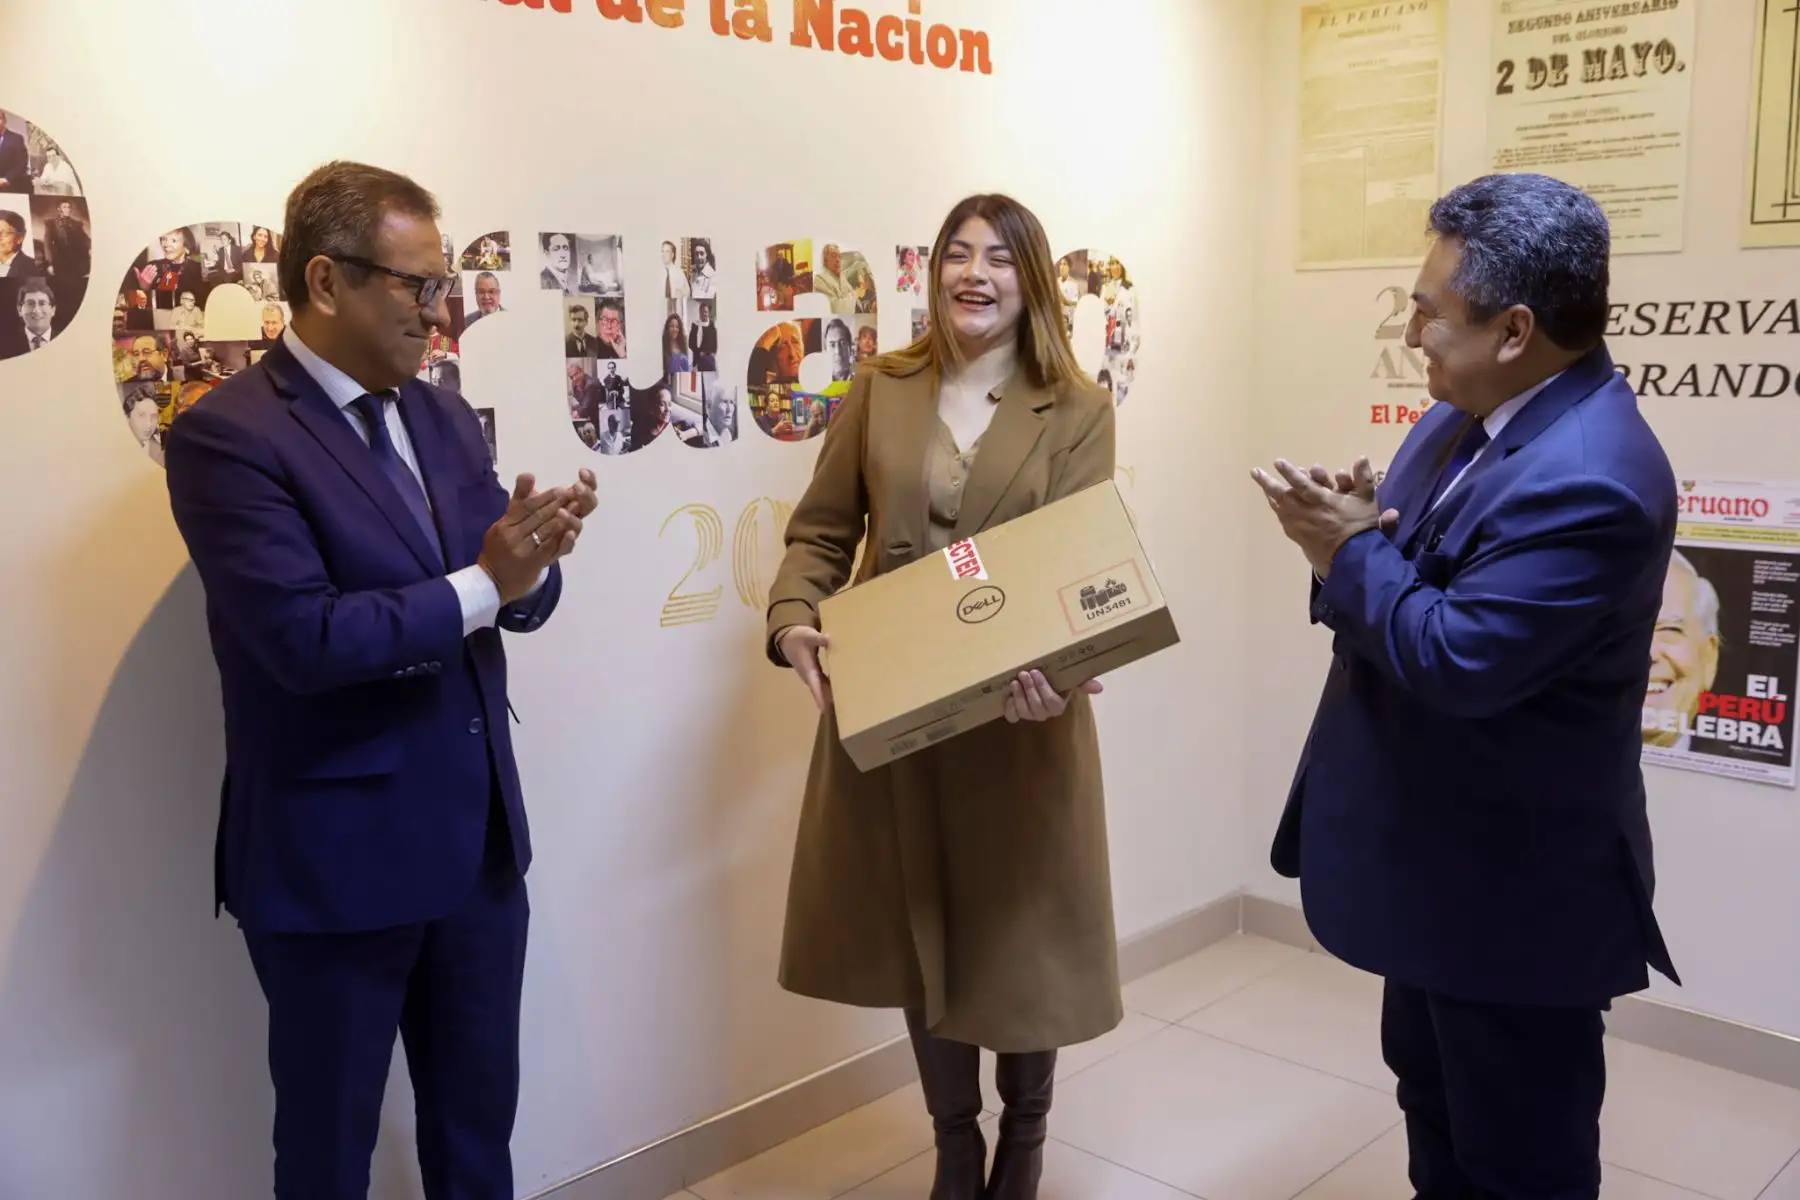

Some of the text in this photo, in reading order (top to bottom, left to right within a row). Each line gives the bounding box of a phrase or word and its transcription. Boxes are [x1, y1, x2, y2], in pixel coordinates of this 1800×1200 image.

[1507, 0, 1679, 34] SEGUNDO ANIVERSARIO
[1495, 38, 1686, 95] 2 DE MAYO.
[1614, 363, 1800, 398] RAND
[1371, 404, 1425, 424] El Pe
[962, 594, 1001, 616] DELL
[1086, 597, 1132, 620] UN3481
[1746, 674, 1788, 701] EL
[1699, 692, 1786, 725] PERÚ
